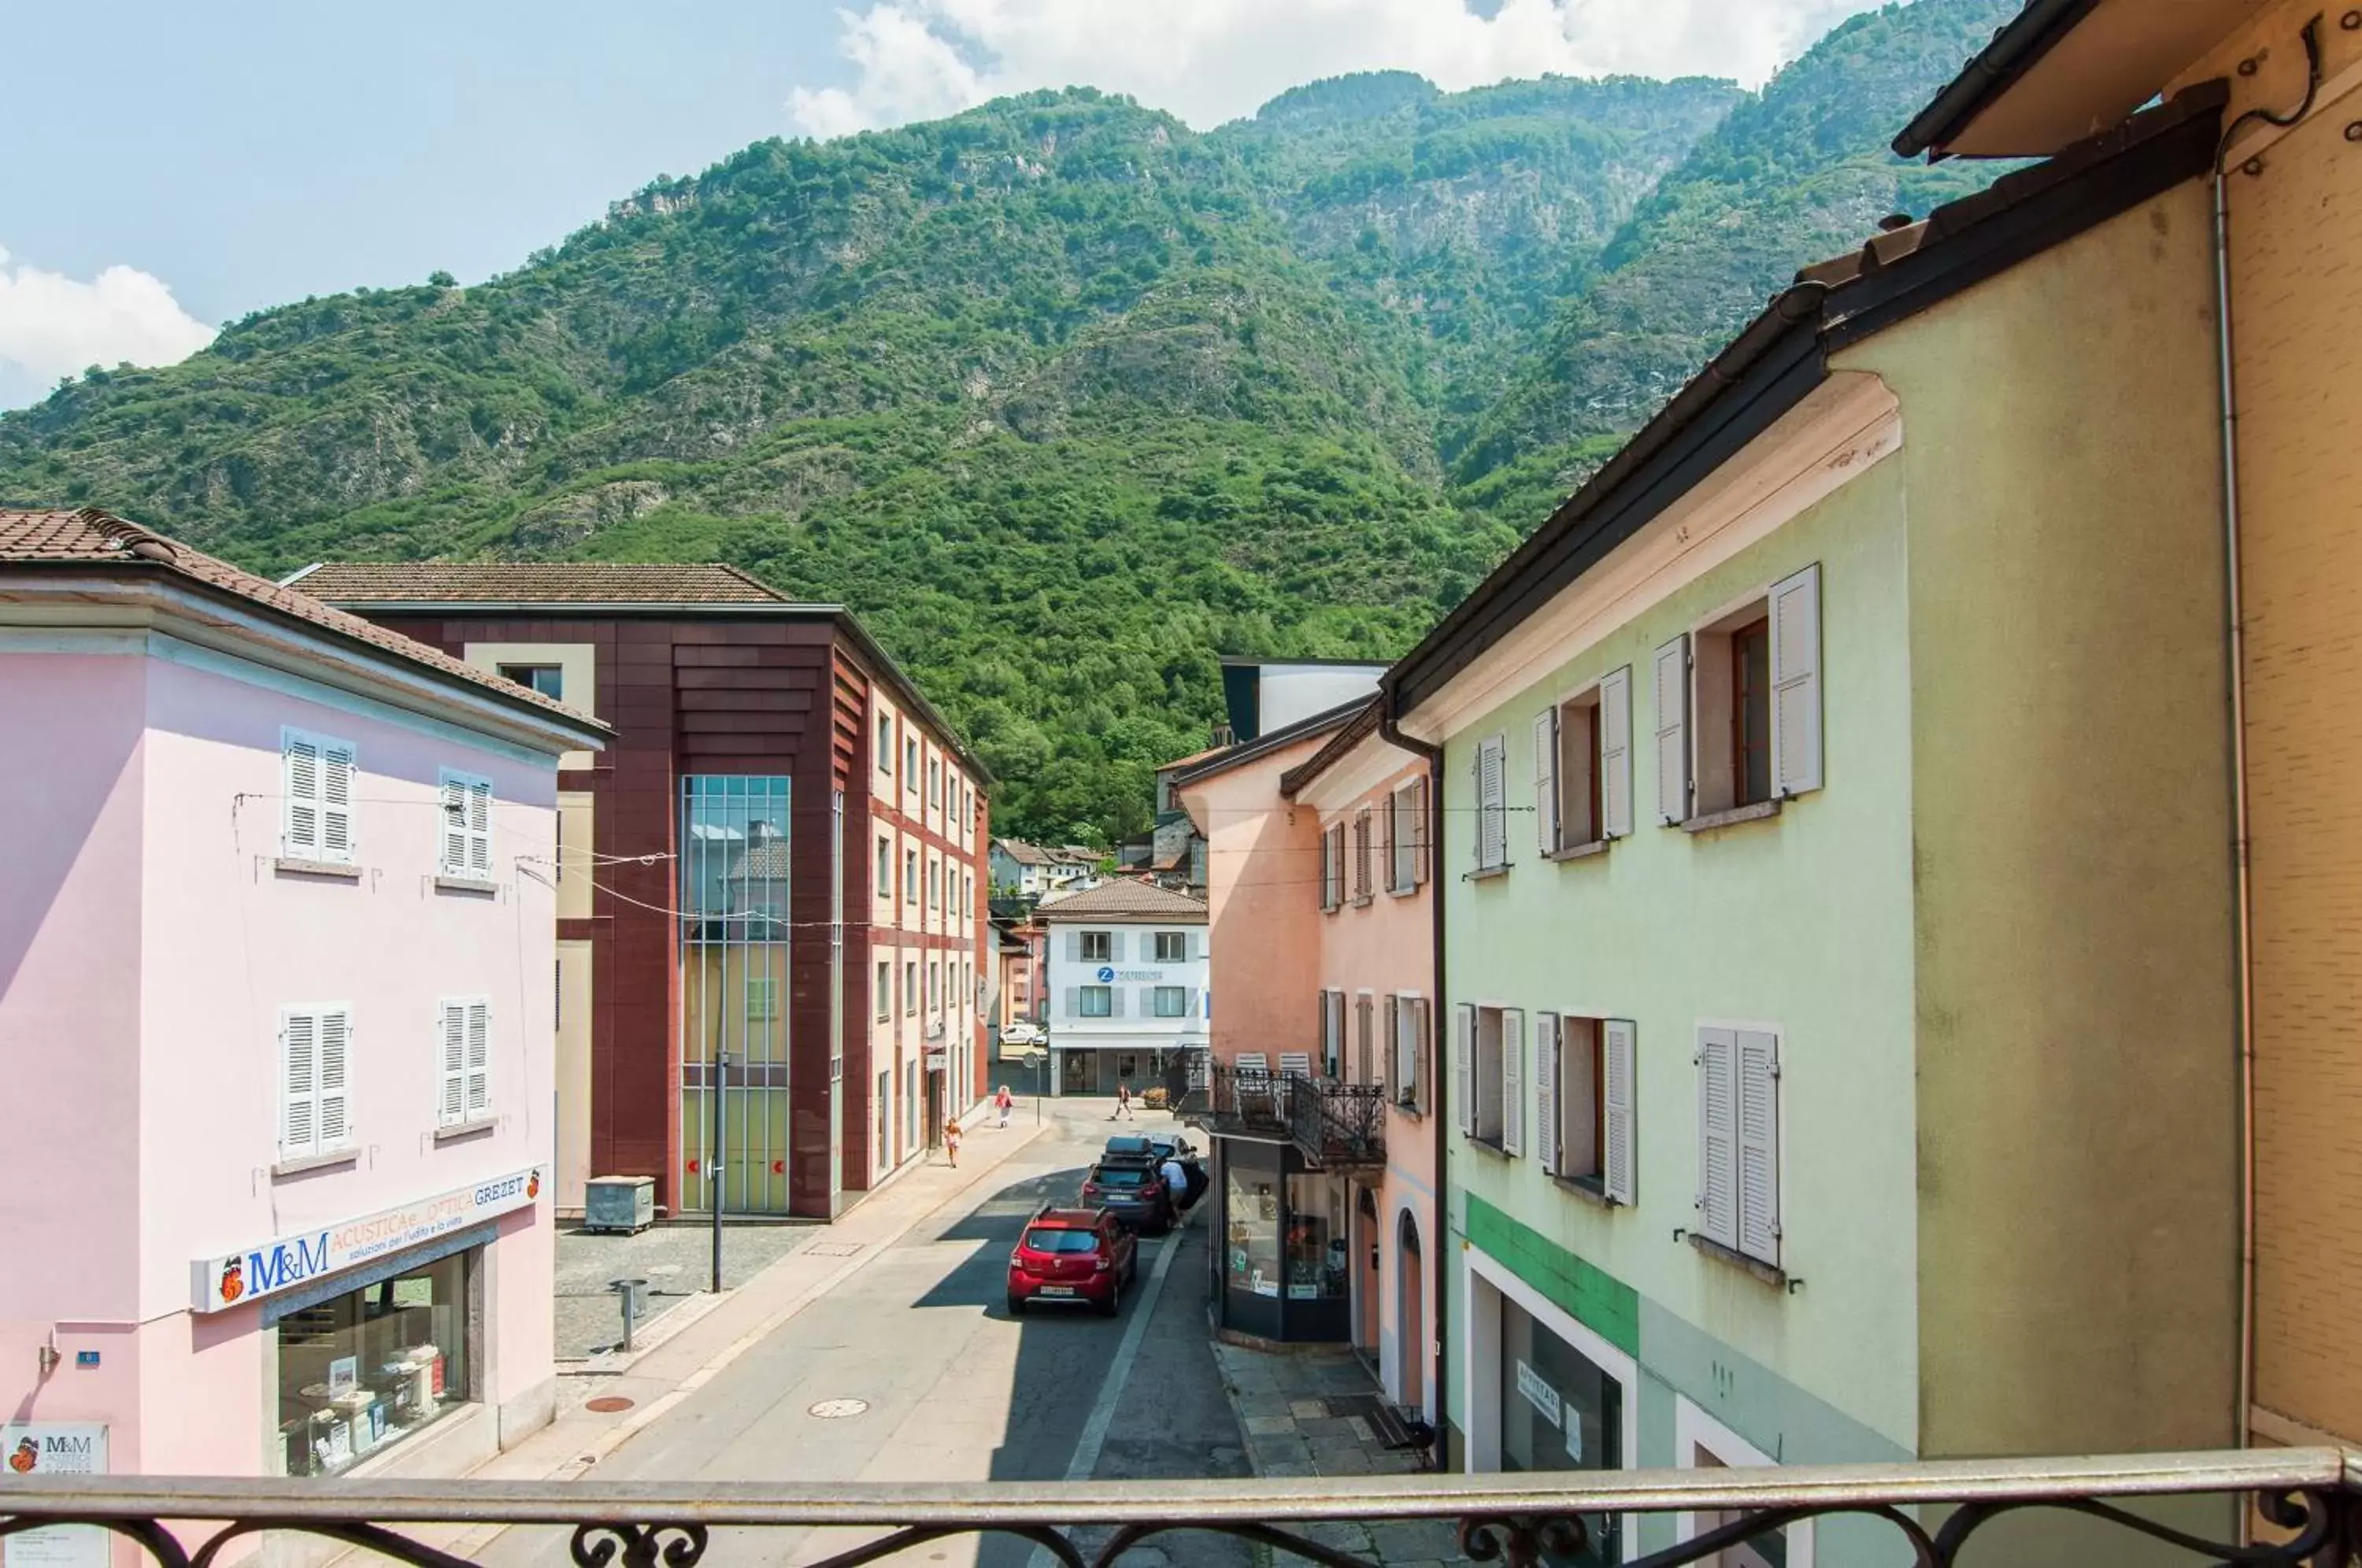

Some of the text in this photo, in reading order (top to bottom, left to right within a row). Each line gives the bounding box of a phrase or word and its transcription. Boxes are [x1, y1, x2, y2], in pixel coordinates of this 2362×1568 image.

[248, 1232, 329, 1296] M&M
[474, 1177, 524, 1206] GREZET
[389, 1237, 402, 1248] per
[46, 1437, 91, 1453] M&M
